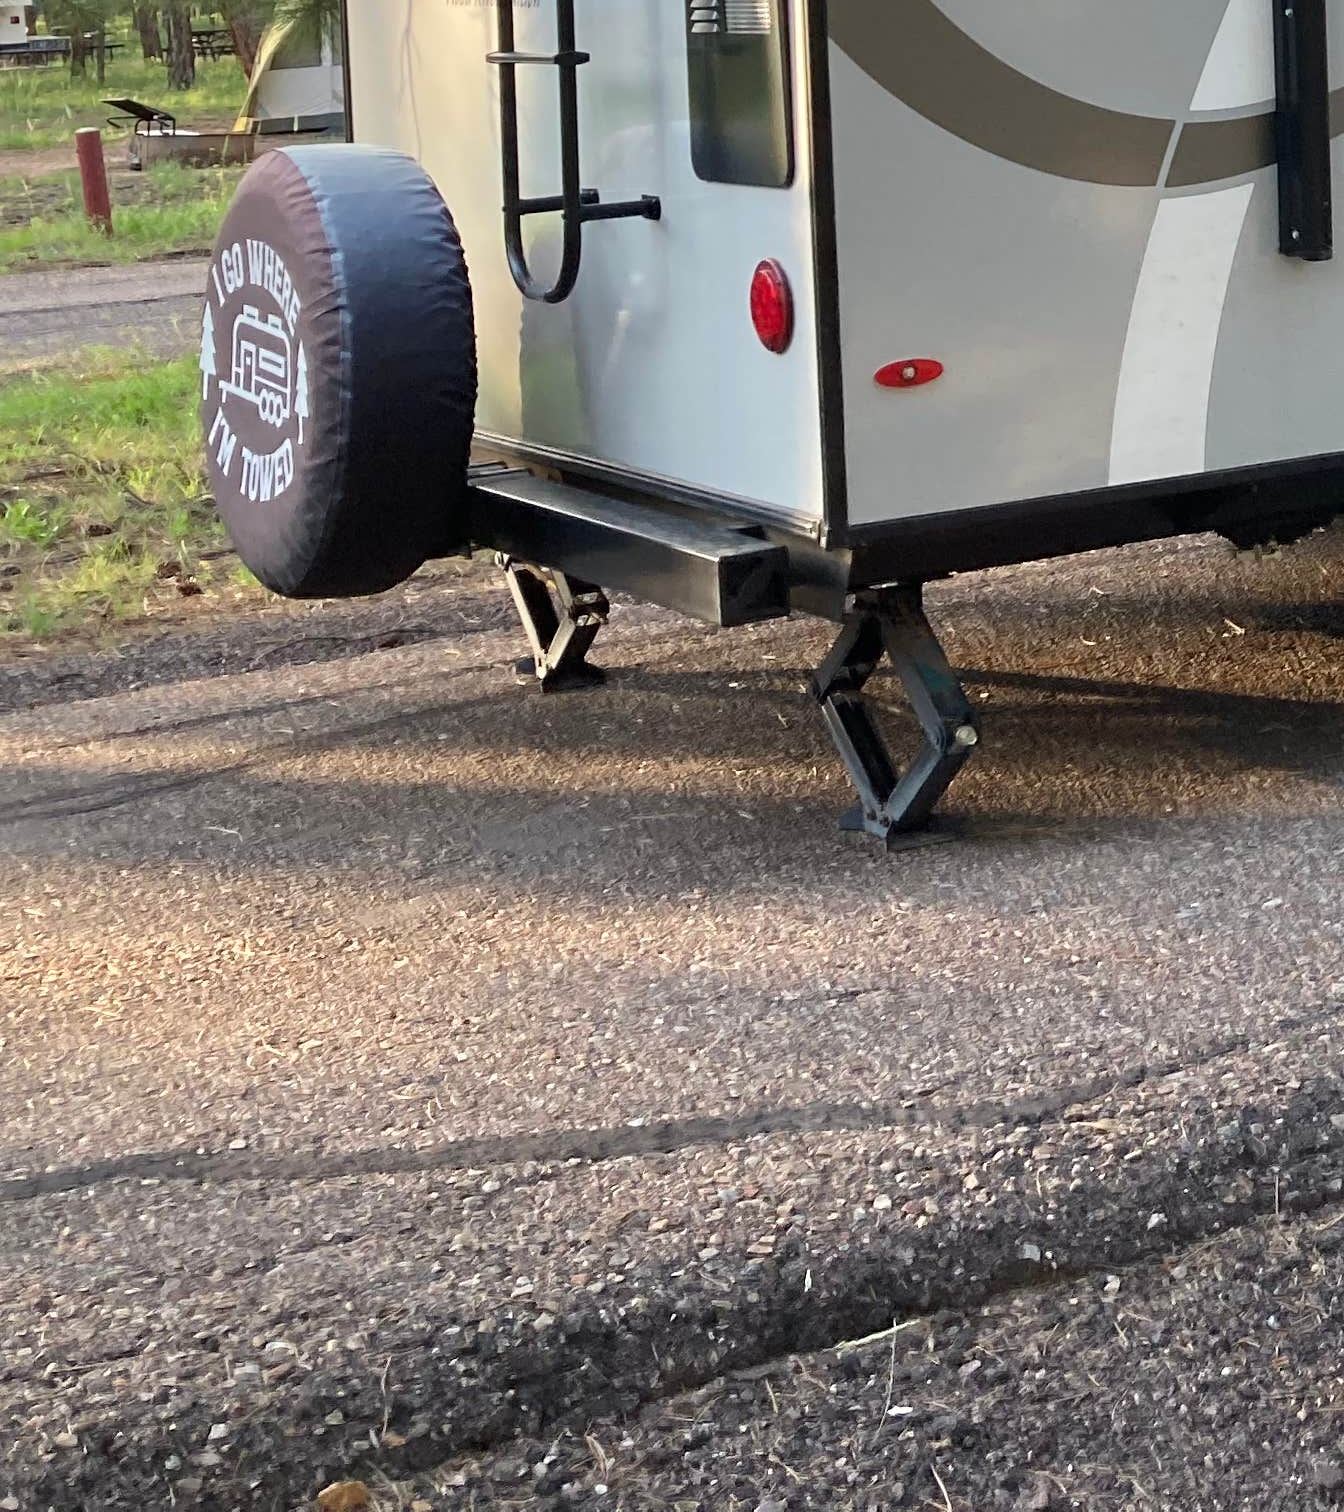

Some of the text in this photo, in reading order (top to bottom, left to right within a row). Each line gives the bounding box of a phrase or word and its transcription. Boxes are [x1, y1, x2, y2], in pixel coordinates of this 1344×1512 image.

[211, 238, 301, 337] I GO WHERE
[207, 405, 294, 503] I'M TOWED
